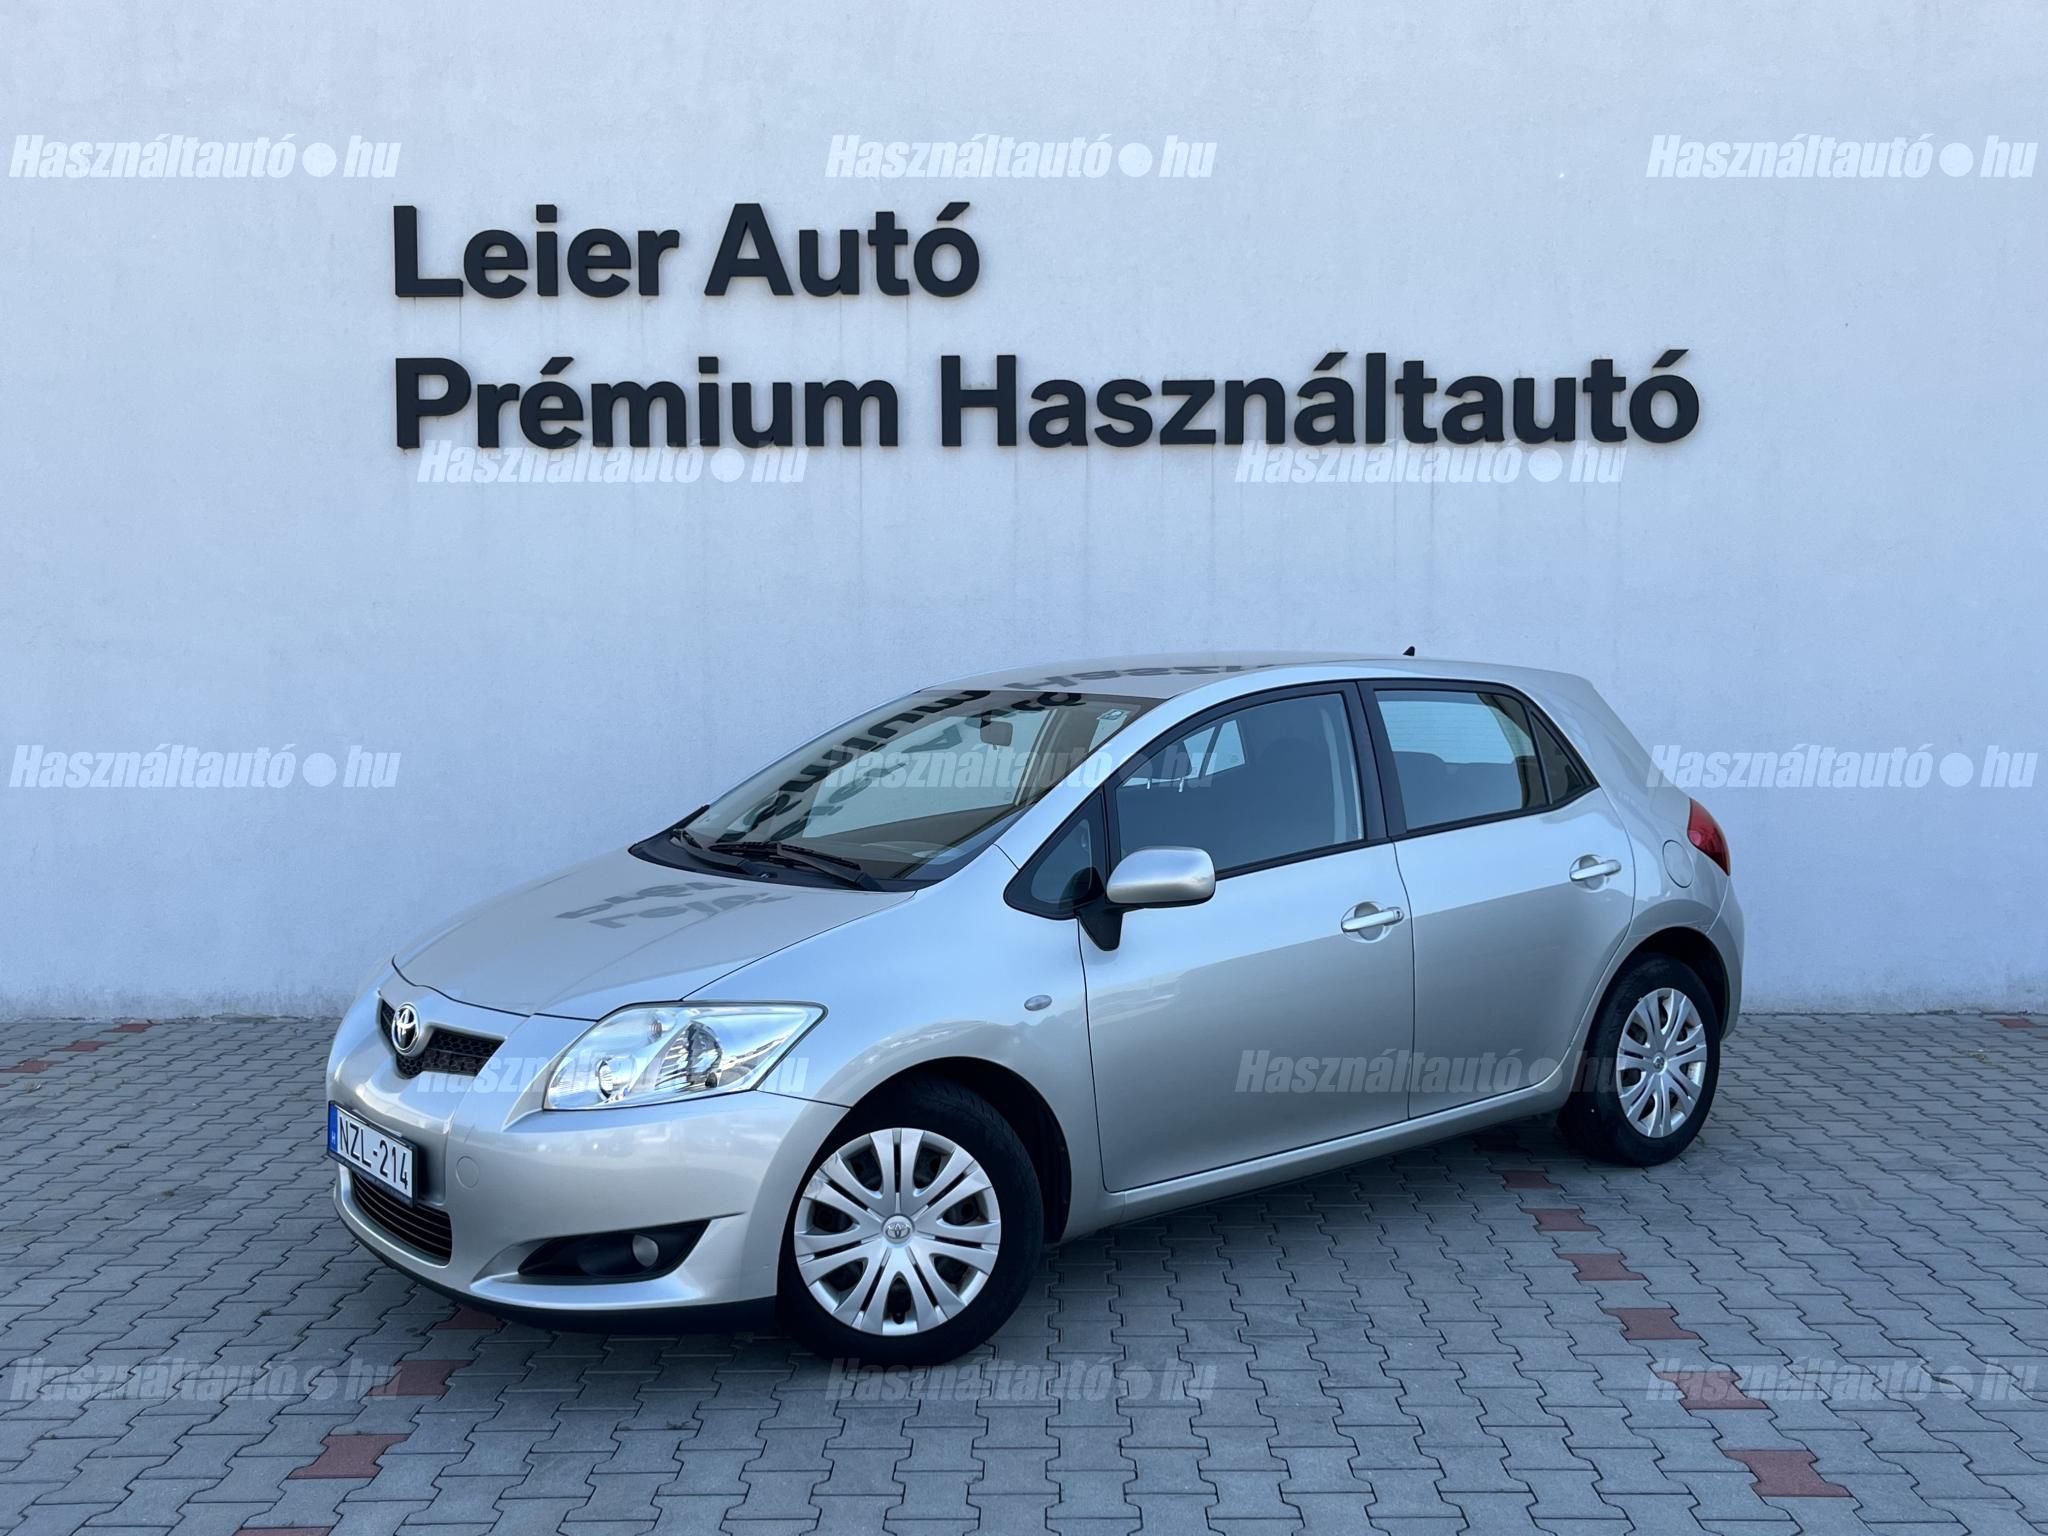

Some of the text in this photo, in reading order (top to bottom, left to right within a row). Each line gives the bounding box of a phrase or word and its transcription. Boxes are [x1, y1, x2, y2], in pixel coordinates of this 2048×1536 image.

[393, 201, 980, 298] Leier Autó
[394, 349, 1701, 449] Prémium Használtautó
[338, 1115, 409, 1191] NZL-214
